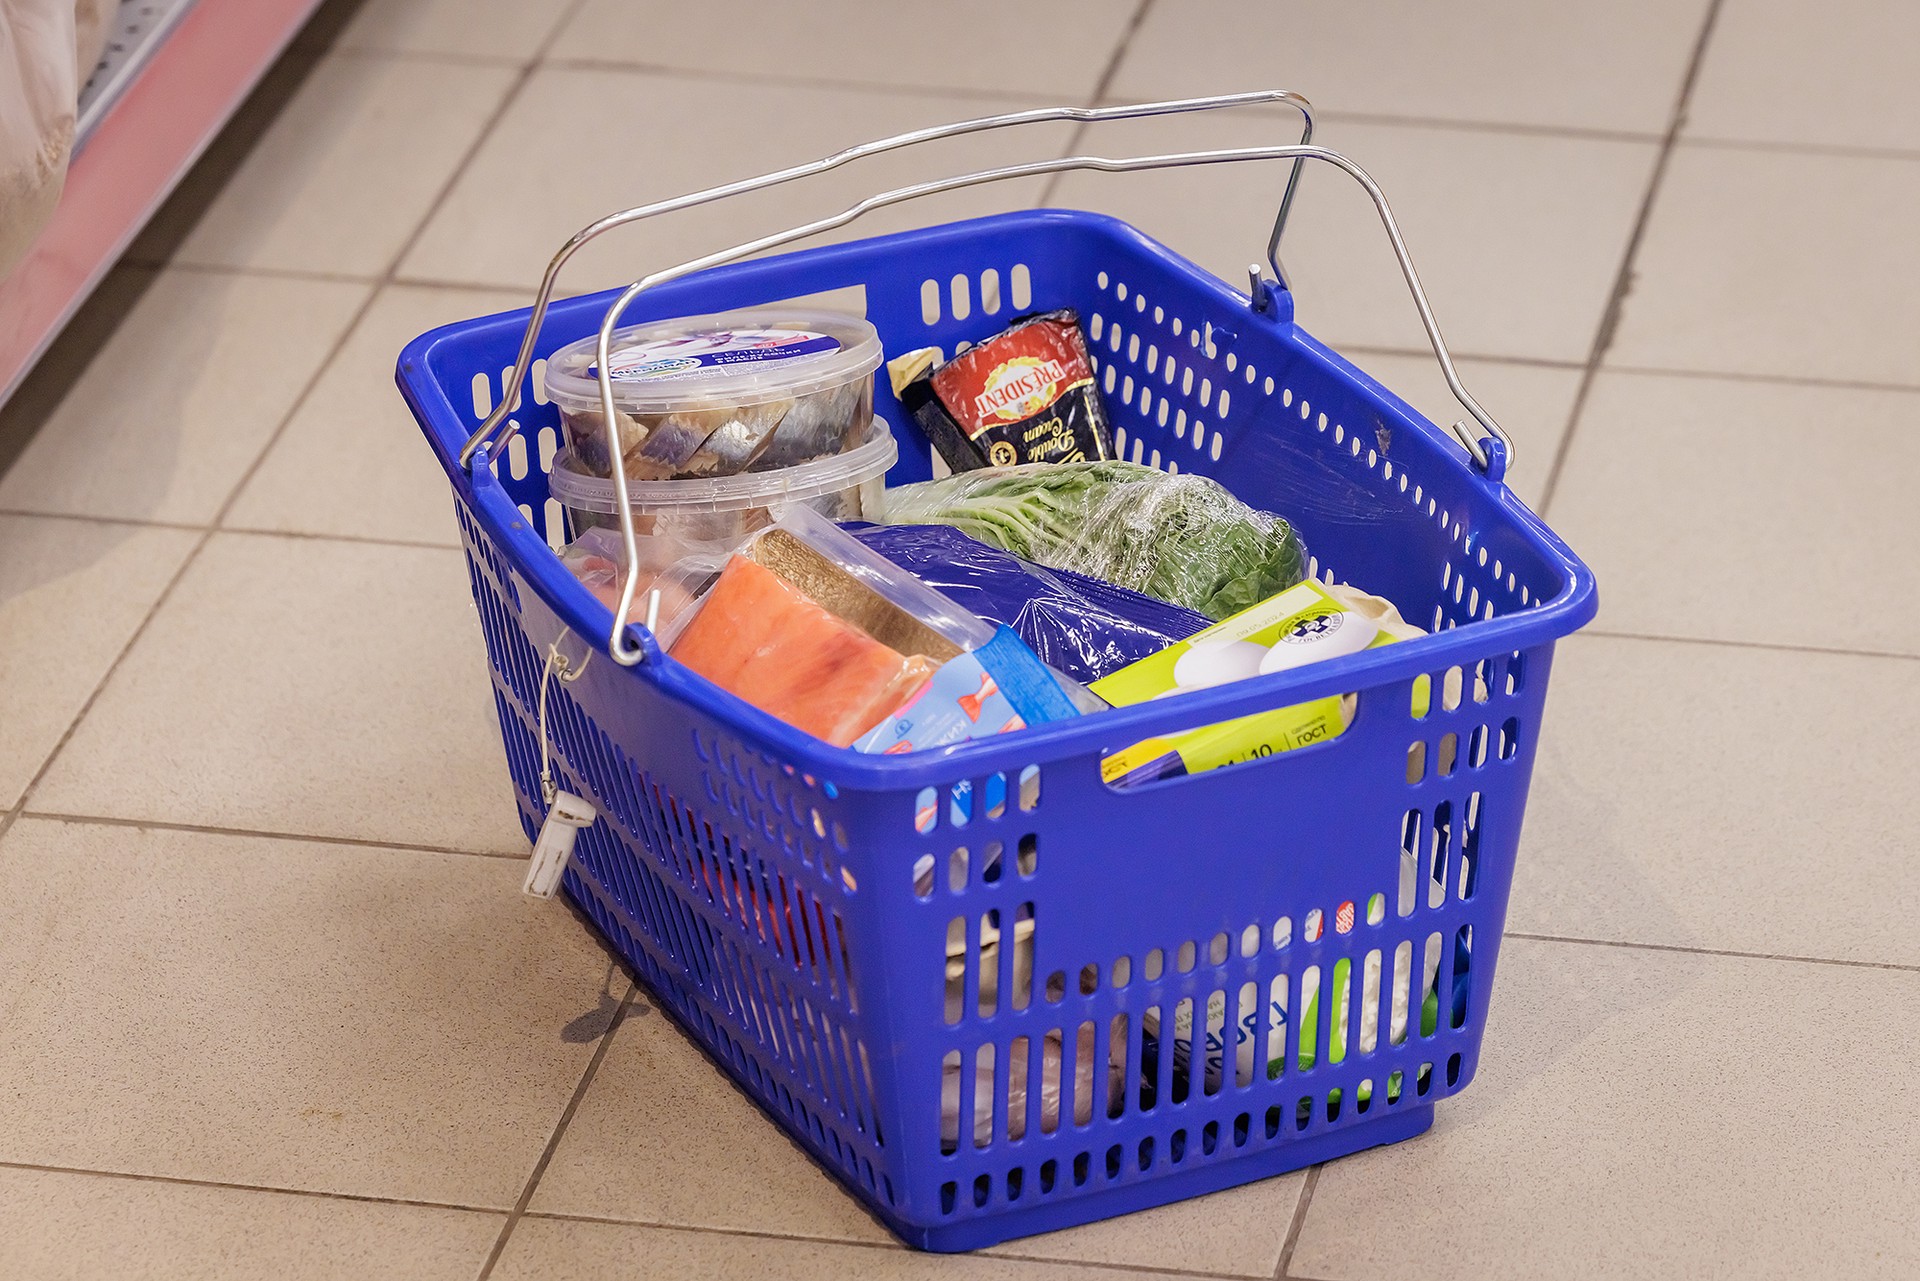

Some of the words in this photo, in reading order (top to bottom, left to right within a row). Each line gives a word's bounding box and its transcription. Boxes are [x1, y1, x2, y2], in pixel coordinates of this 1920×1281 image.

[978, 361, 1062, 415] PRÉSIDENT
[1022, 417, 1063, 442] Cream
[1027, 429, 1075, 461] Double
[1296, 723, 1327, 746] ГОСТ
